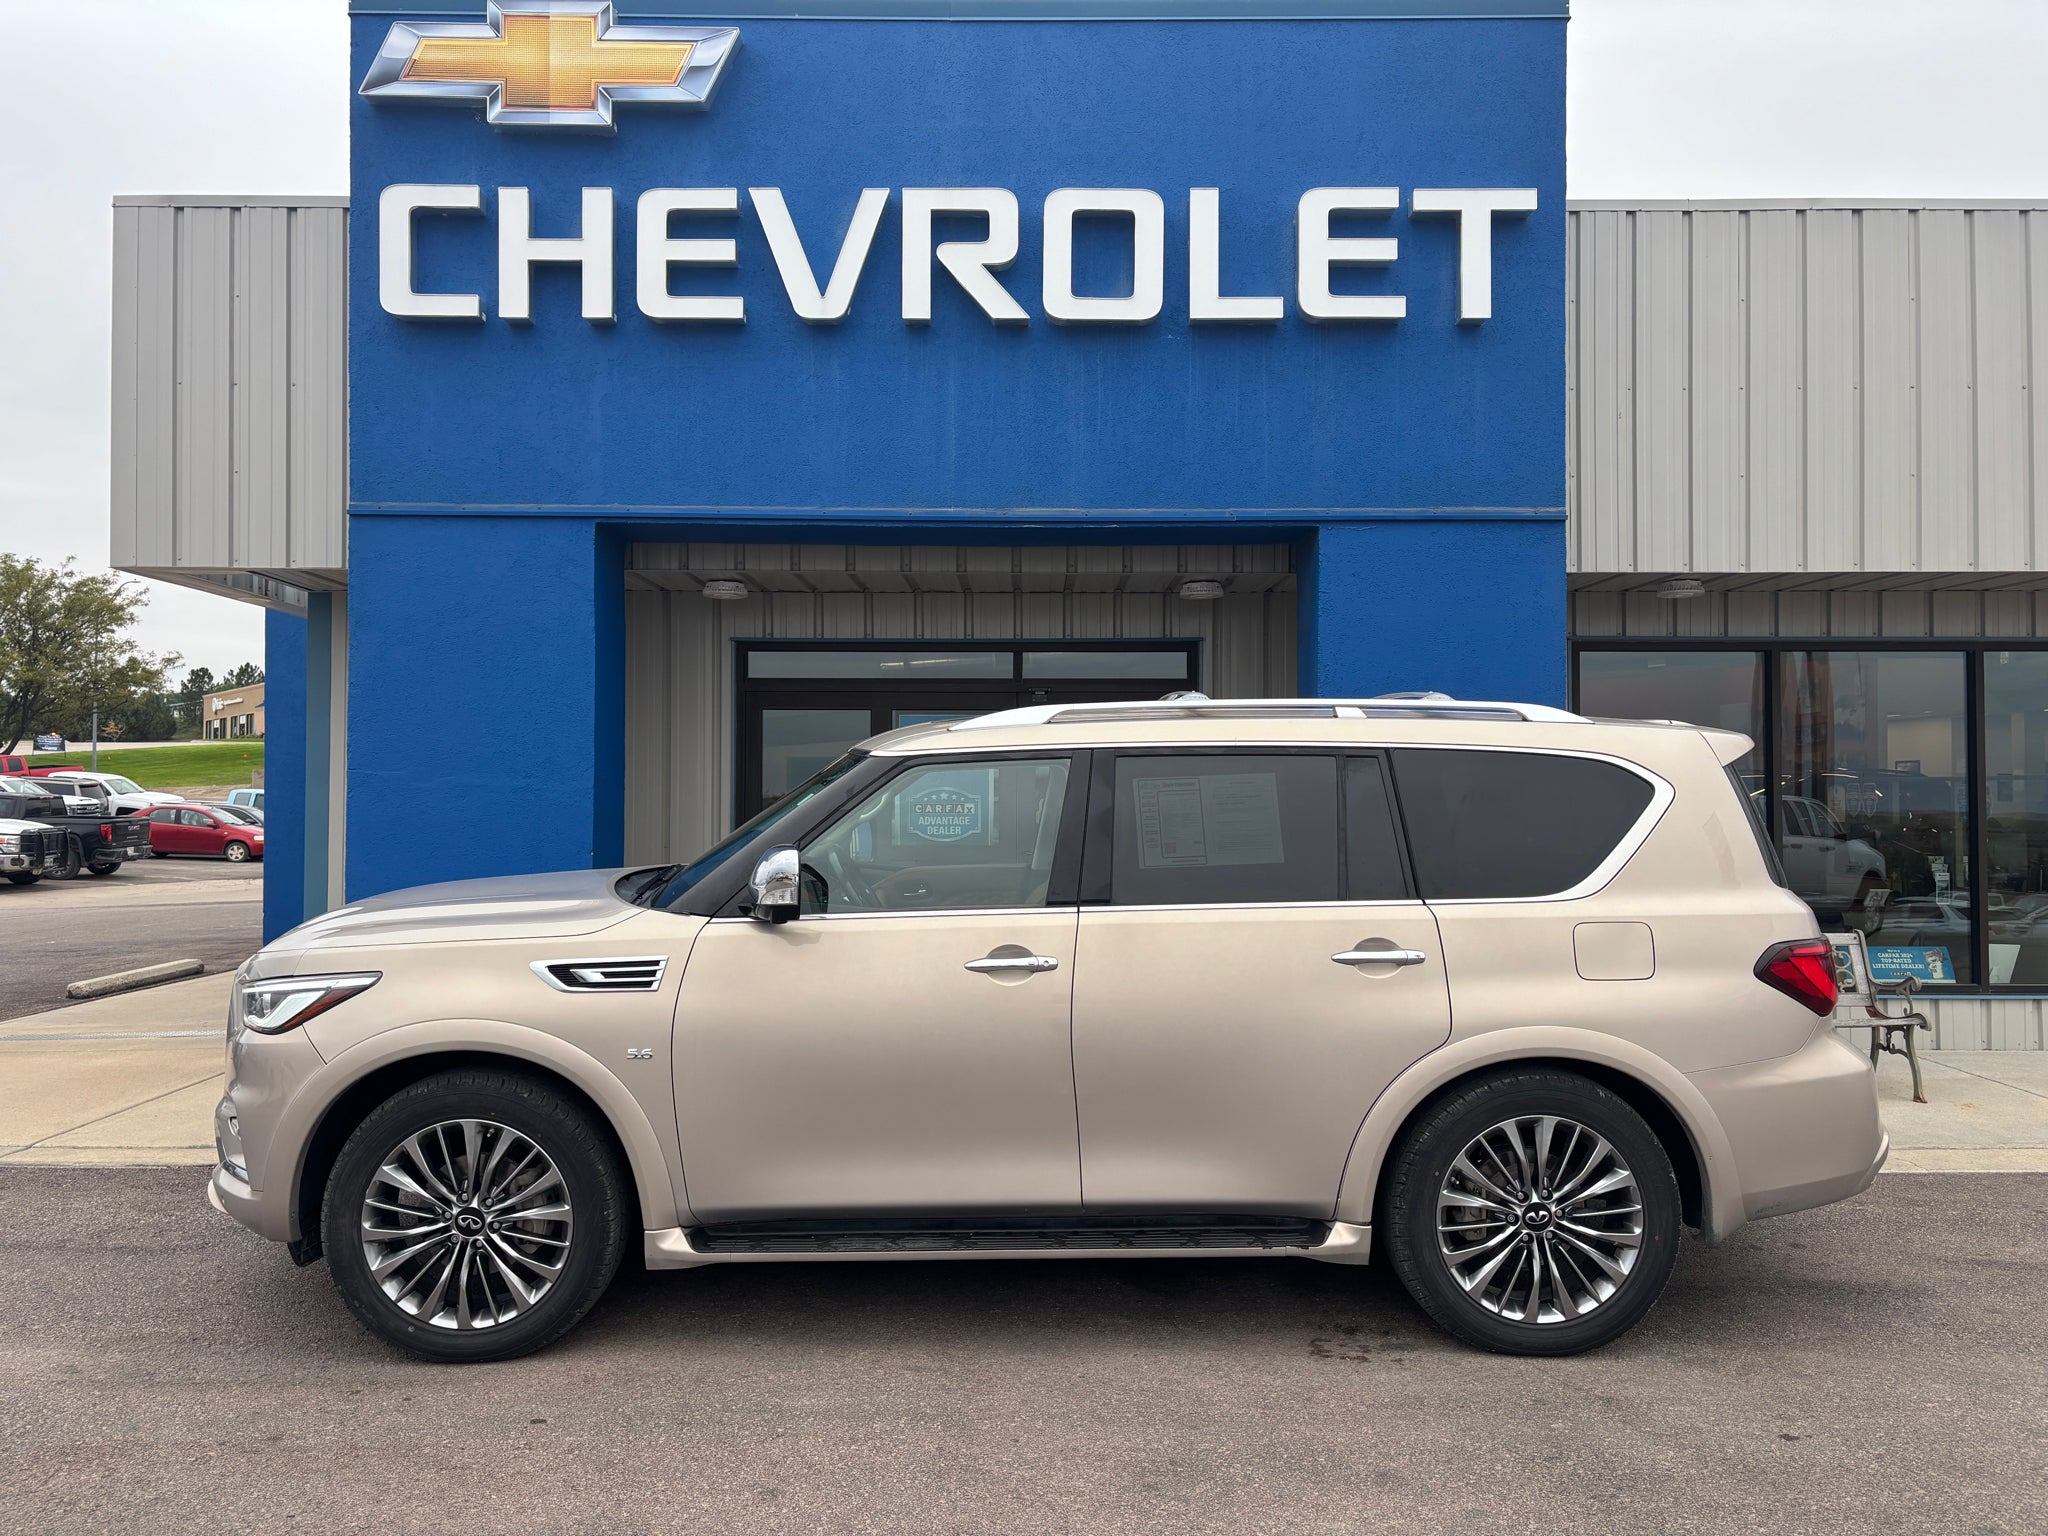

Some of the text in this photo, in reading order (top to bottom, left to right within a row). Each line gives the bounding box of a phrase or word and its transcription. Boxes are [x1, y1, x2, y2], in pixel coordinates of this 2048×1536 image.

[377, 184, 1539, 322] CHEVROLET
[914, 803, 974, 814] CARFAX
[919, 817, 970, 825] ADVANTAGE
[928, 826, 961, 834] DEALER
[626, 1048, 654, 1060] 5.6
